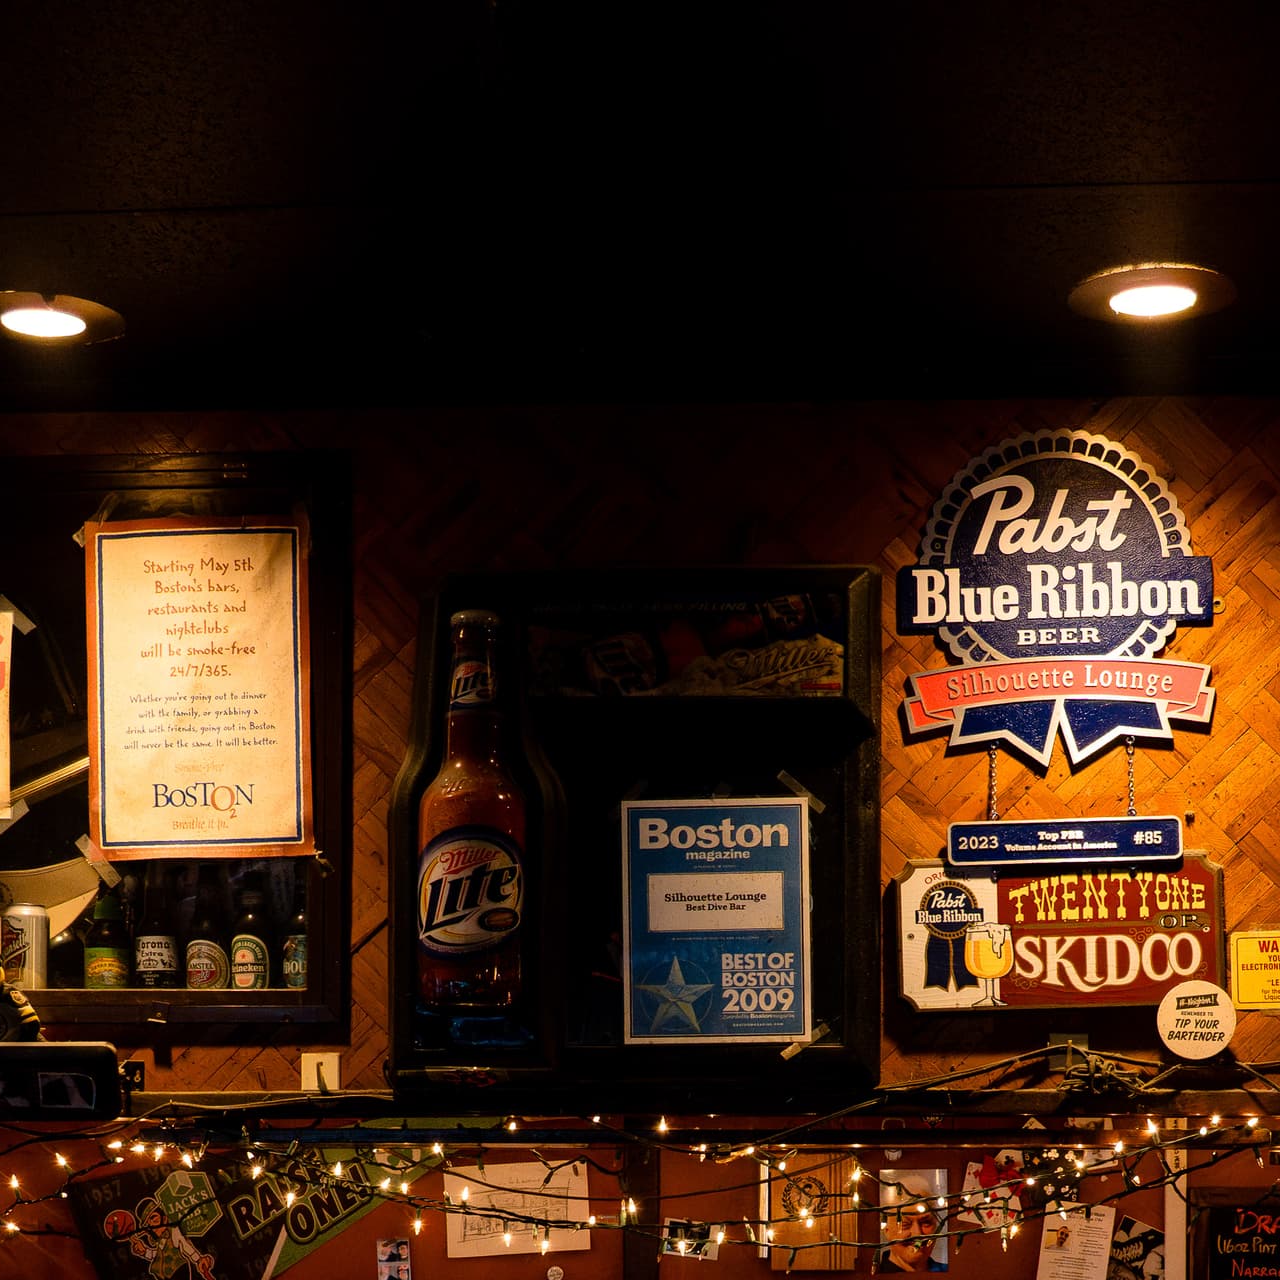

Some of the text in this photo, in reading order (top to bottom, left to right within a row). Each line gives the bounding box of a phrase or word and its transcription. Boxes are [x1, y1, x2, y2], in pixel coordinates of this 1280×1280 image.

[971, 475, 1133, 555] Pabst
[143, 557, 255, 575] Starting May 5th
[155, 579, 240, 594] Boston's bars,
[911, 561, 1203, 624] Blue Ribbon
[148, 601, 246, 616] restaurants and
[166, 622, 229, 640] nightclubs
[1017, 627, 1100, 645] BEER
[141, 642, 256, 658] will be smoke-free
[170, 664, 231, 678] 24/7/365.
[947, 664, 1174, 699] Silhouette Lounge
[639, 817, 789, 850] Boston
[1038, 832, 1059, 841] Top
[1133, 831, 1162, 845] #85
[958, 836, 999, 850] 2023
[685, 848, 751, 862] magazine
[419, 864, 518, 939] Lite
[664, 892, 767, 902] Silhouette Lounge
[930, 890, 965, 909] Pabst
[708, 903, 728, 911] Dive
[916, 909, 982, 924] Blue Ribbon
[722, 953, 794, 970] BEST OF
[722, 972, 794, 987] BOSTON
[722, 989, 794, 1012] 2009
[1175, 1019, 1219, 1028] TIP YOUR
[1167, 1031, 1225, 1042] BARTENDER
